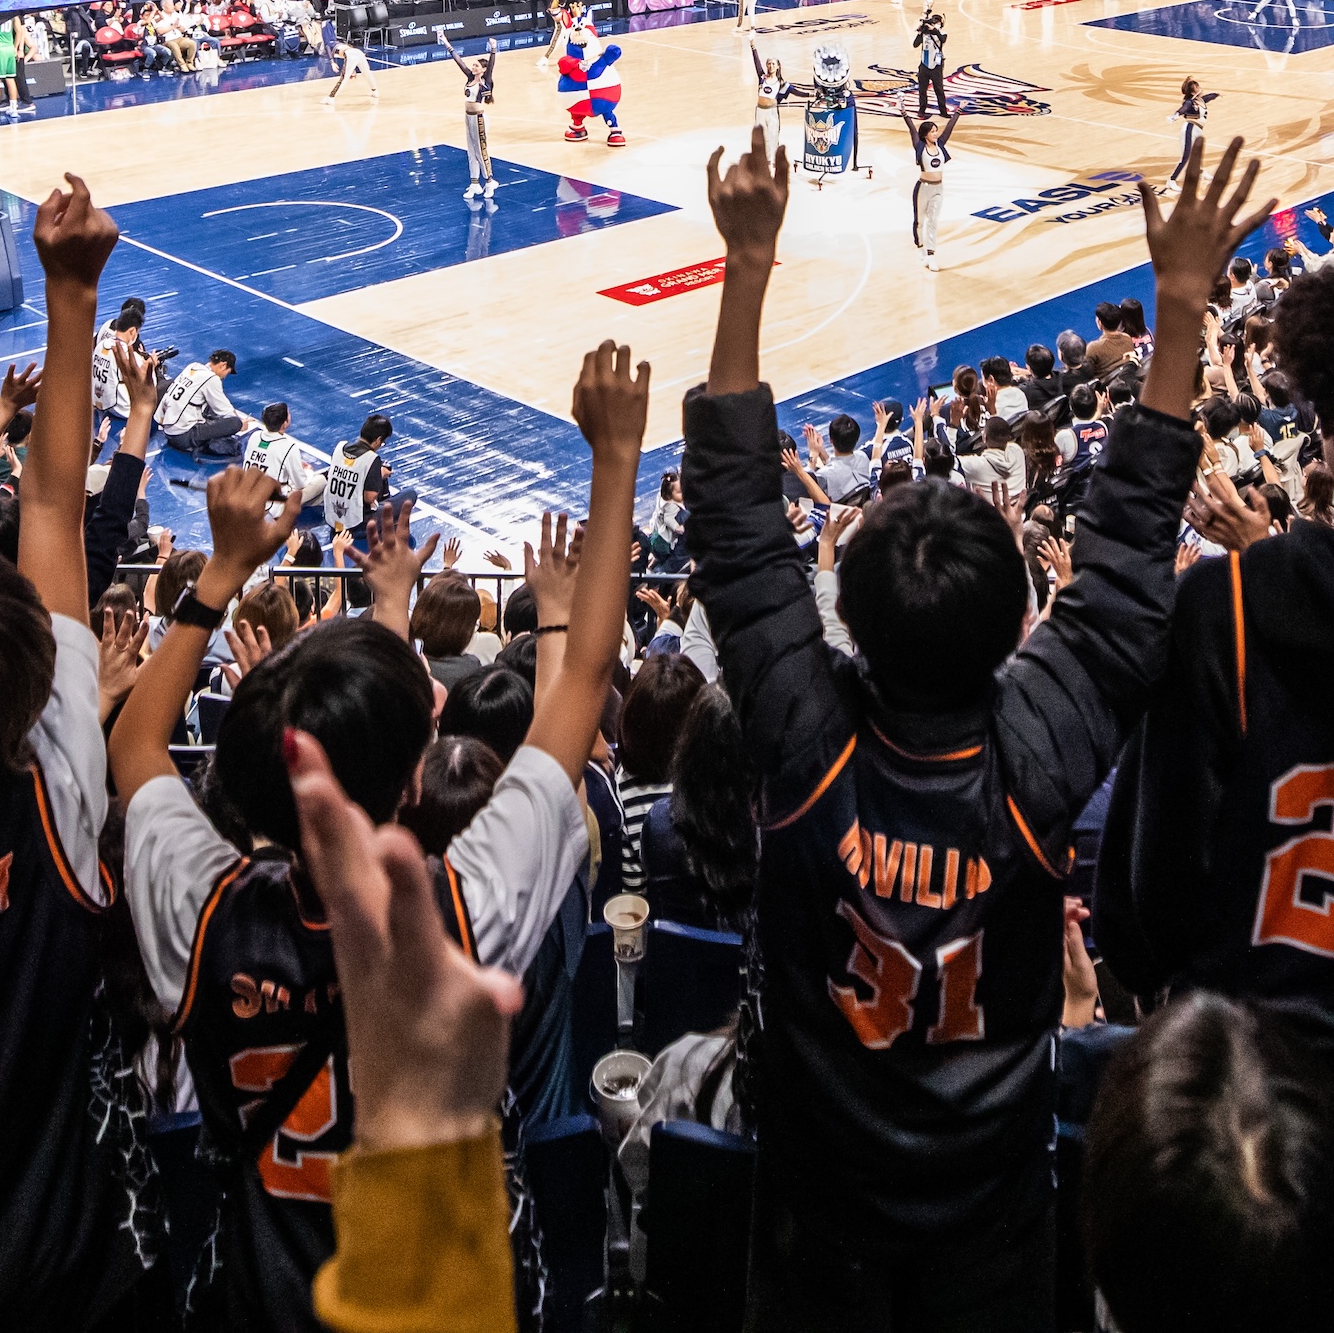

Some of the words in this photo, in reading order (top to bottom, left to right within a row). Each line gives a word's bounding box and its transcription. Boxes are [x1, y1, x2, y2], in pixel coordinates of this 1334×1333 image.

[400, 25, 427, 38] SPALDING
[805, 153, 842, 166] RYUKYU
[970, 182, 1122, 223] EASL
[657, 266, 709, 284] OKINAWA
[660, 274, 698, 288] GRAND
[93, 354, 110, 369] PHOTO
[250, 450, 267, 464] ENG
[332, 465, 359, 483] PHOTO
[329, 477, 357, 500] 007
[827, 898, 986, 1050] 31
